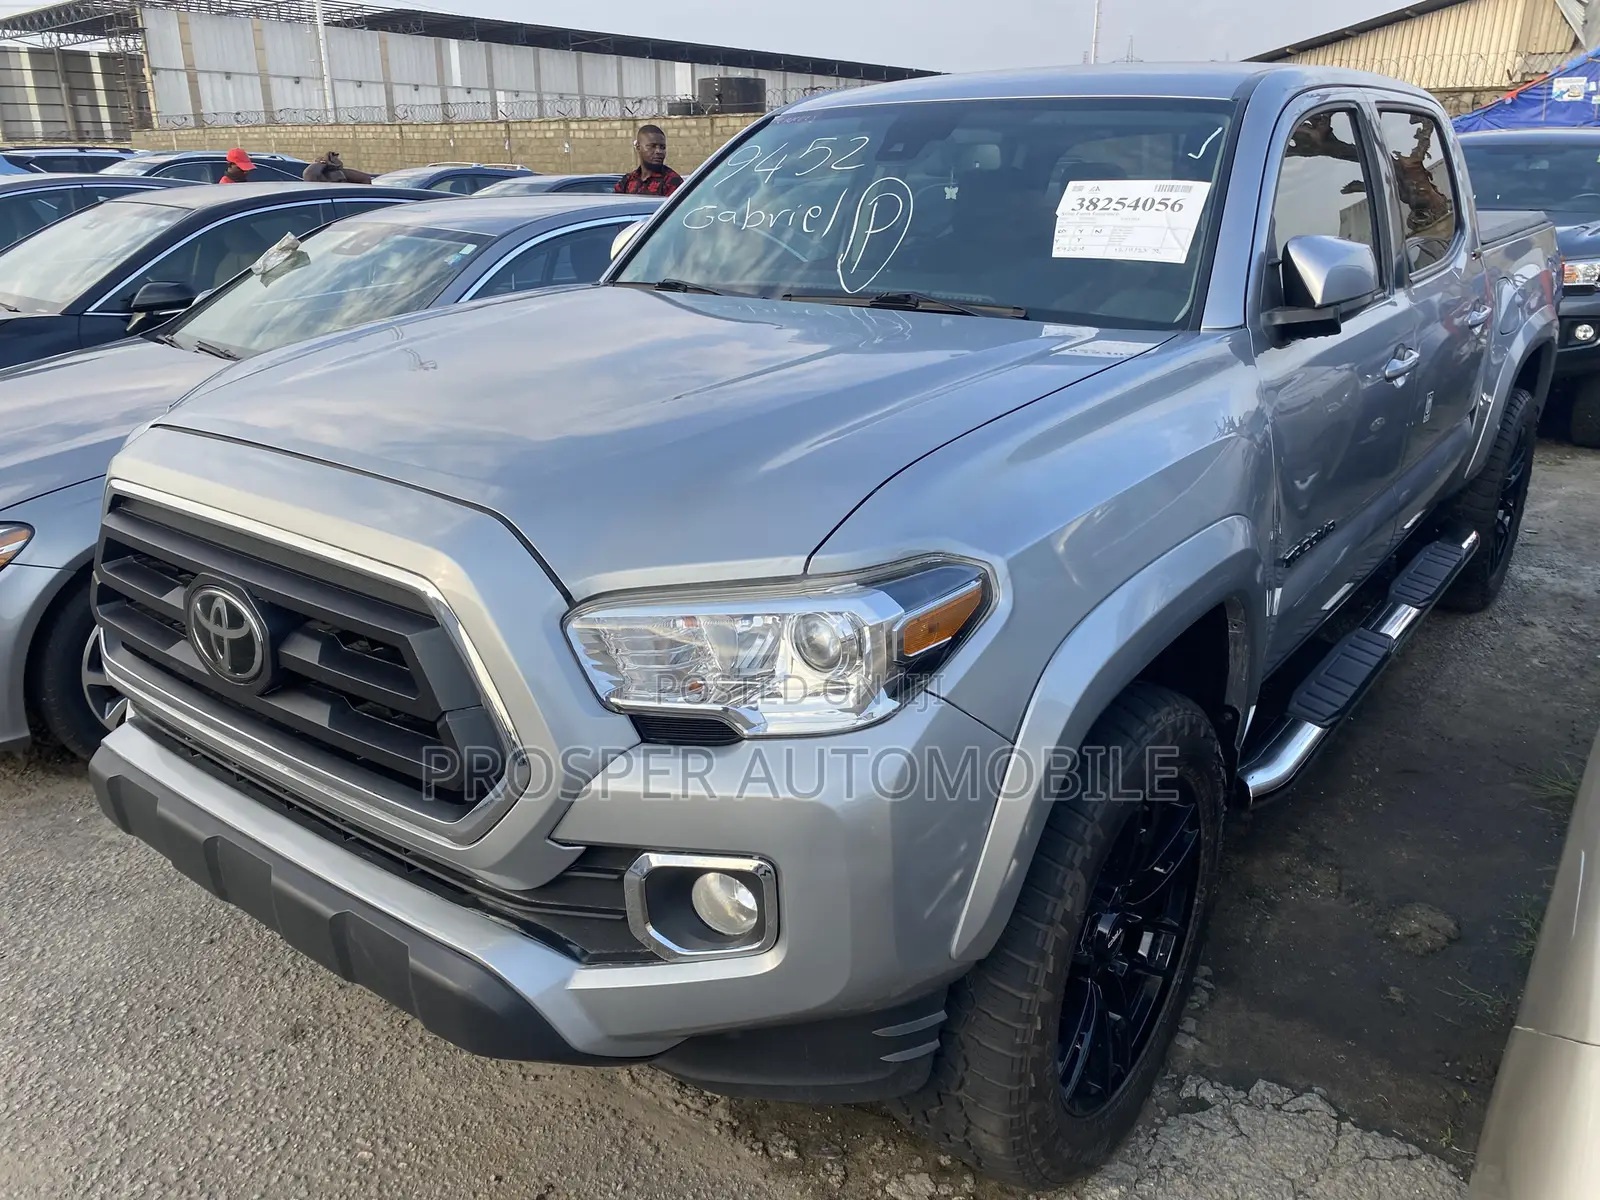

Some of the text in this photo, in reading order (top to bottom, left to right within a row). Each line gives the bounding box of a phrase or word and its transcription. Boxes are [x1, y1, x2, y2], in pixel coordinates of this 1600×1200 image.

[714, 136, 870, 188] 9452
[683, 187, 848, 237] Gabriel
[1071, 197, 1186, 213] 38254056
